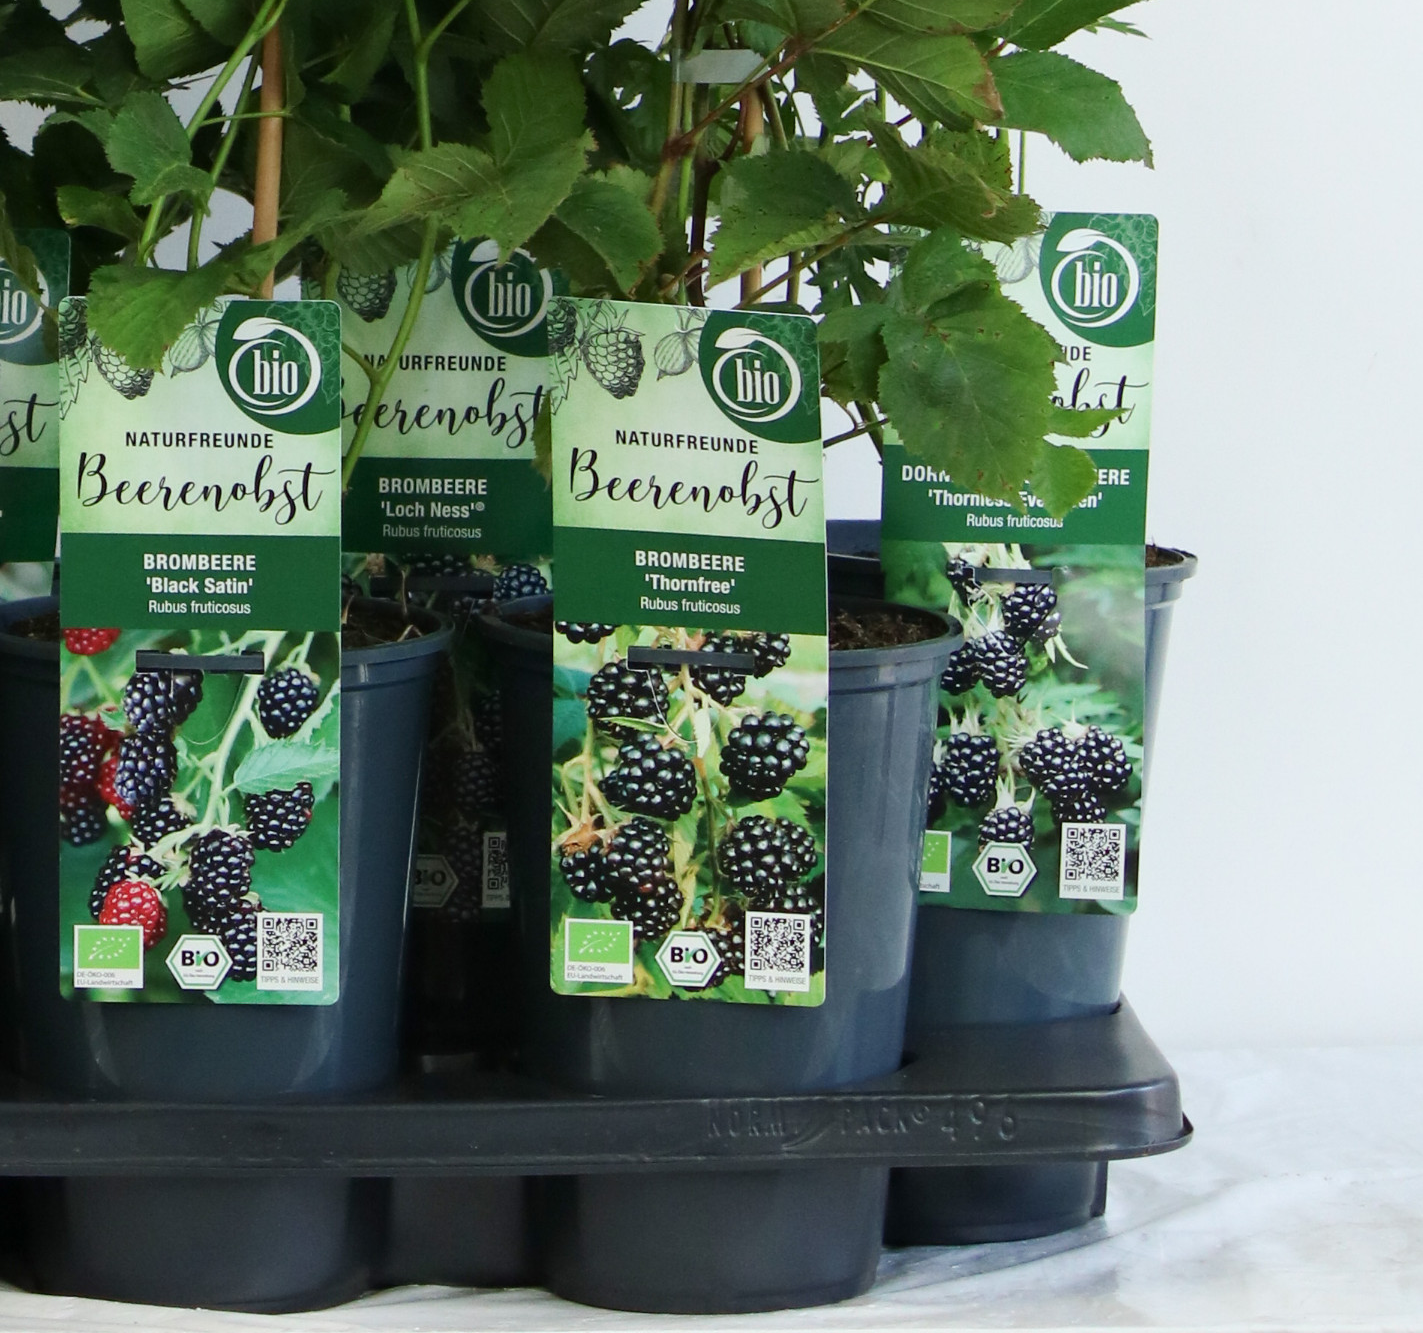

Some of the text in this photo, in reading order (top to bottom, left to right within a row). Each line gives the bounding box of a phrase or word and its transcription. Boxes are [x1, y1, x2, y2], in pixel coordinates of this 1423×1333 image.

[1074, 261, 1117, 308] bio
[487, 271, 531, 317] bio
[253, 349, 298, 395] bio
[363, 354, 506, 372] NAURFREUNDE
[735, 358, 780, 404] bio
[341, 377, 546, 449] eerenobst
[126, 432, 274, 448] NATURFREUNDE
[615, 430, 759, 454] NATURFREUNDE
[77, 452, 336, 525] Beerenobst
[379, 478, 487, 495] BROMBEERE
[570, 447, 819, 529] Beerenobst
[381, 501, 424, 517] 'Loch
[966, 514, 1003, 527] Rubus
[382, 524, 481, 539] Rubus fruticosus
[143, 554, 256, 571] BROMBEERE
[635, 550, 745, 572] BROMBEERE
[146, 578, 253, 594] 'Black Satin'
[645, 573, 735, 594] 'Thornfree'
[148, 600, 251, 614] Rubus fruticosus
[640, 597, 741, 615] Rubus fruticosus
[1063, 884, 1081, 892] TIPPS
[1089, 885, 1120, 893] HINWEISE
[287, 976, 319, 984] HINWEISE
[748, 974, 806, 984] TIPPS & HINWEISE
